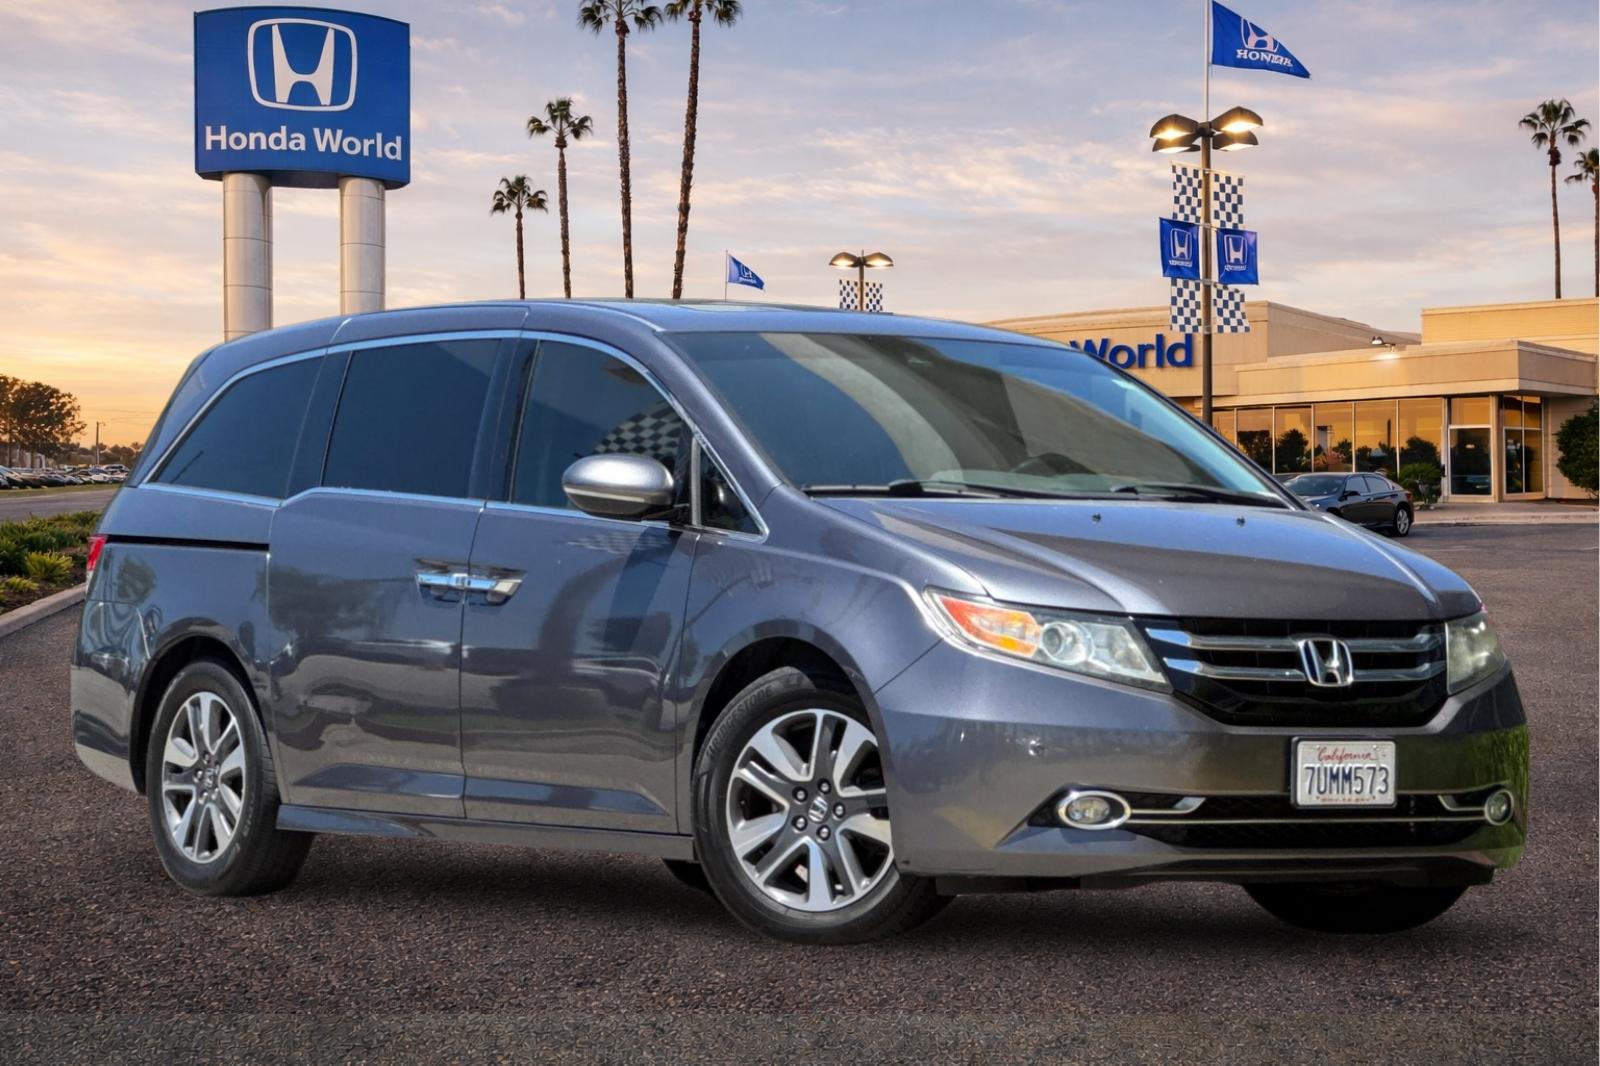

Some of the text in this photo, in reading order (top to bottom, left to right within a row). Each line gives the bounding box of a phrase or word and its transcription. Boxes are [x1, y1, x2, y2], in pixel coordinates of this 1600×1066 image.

[205, 125, 402, 161] Honda World
[1316, 745, 1378, 764] California
[1304, 765, 1390, 796] 7UMM573
